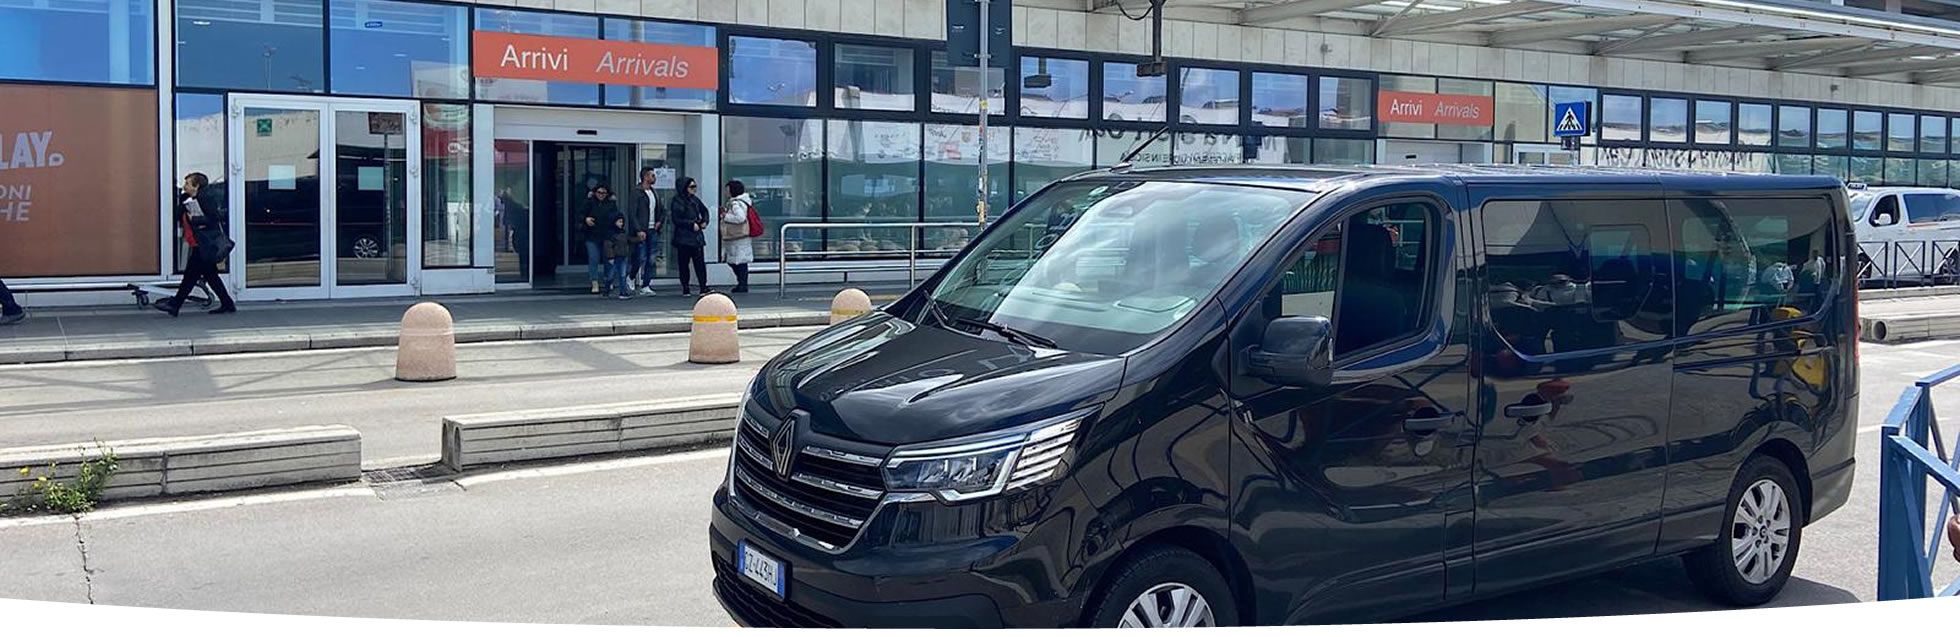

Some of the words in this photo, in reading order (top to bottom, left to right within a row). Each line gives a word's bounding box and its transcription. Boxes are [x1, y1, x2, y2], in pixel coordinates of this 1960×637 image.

[500, 44, 568, 71] Arrivi
[595, 51, 690, 79] Arrivals
[1390, 98, 1423, 116] Arrivi
[1434, 101, 1481, 119] Arrivals
